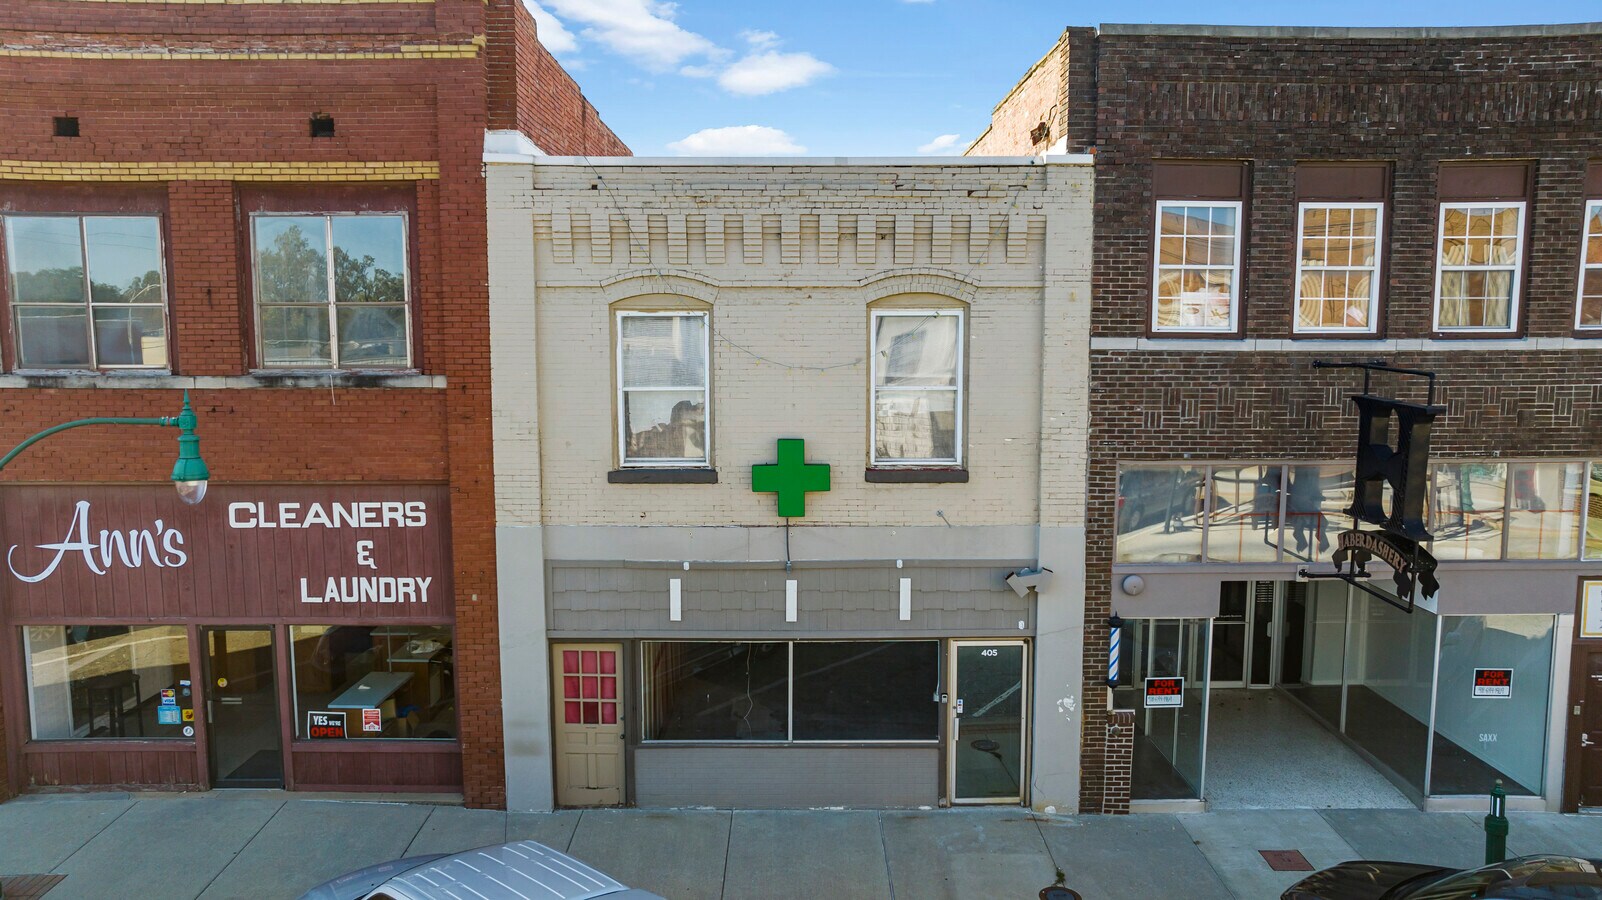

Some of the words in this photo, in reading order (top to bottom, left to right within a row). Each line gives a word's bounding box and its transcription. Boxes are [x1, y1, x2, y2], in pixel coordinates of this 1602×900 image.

[229, 501, 427, 529] CLEANERS
[8, 500, 188, 583] Ann's
[356, 540, 377, 569] &
[1338, 532, 1407, 573] HABERDASHERY
[300, 577, 432, 603] LAUNDRY
[981, 649, 998, 657] 405
[1477, 678, 1509, 686] RENT
[1148, 687, 1180, 695] RENT
[313, 715, 328, 726] YES
[311, 727, 343, 737] OPEN
[1479, 733, 1498, 742] SAXX
